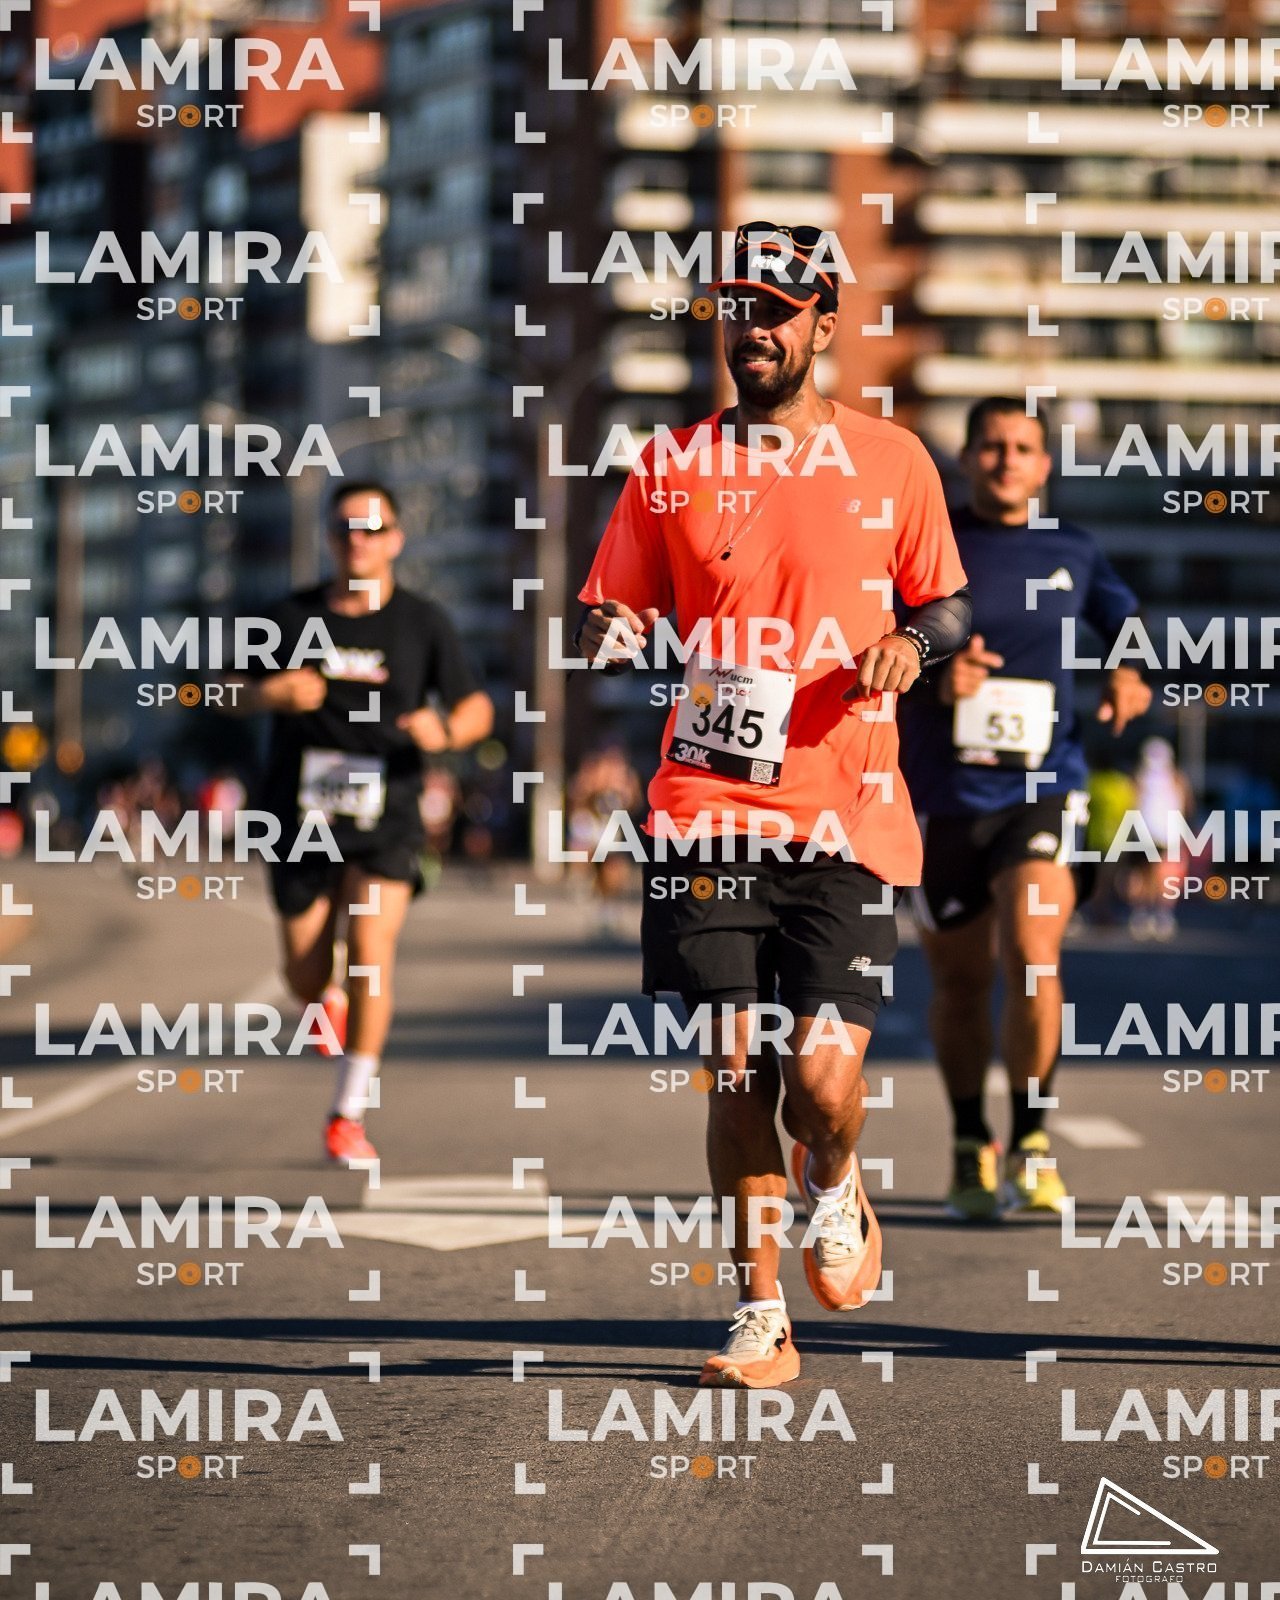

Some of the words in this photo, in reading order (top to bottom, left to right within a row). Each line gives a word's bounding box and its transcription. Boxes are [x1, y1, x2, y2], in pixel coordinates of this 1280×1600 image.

[730, 673, 754, 685] ucm
[691, 696, 764, 749] 345
[985, 711, 1025, 742] 53
